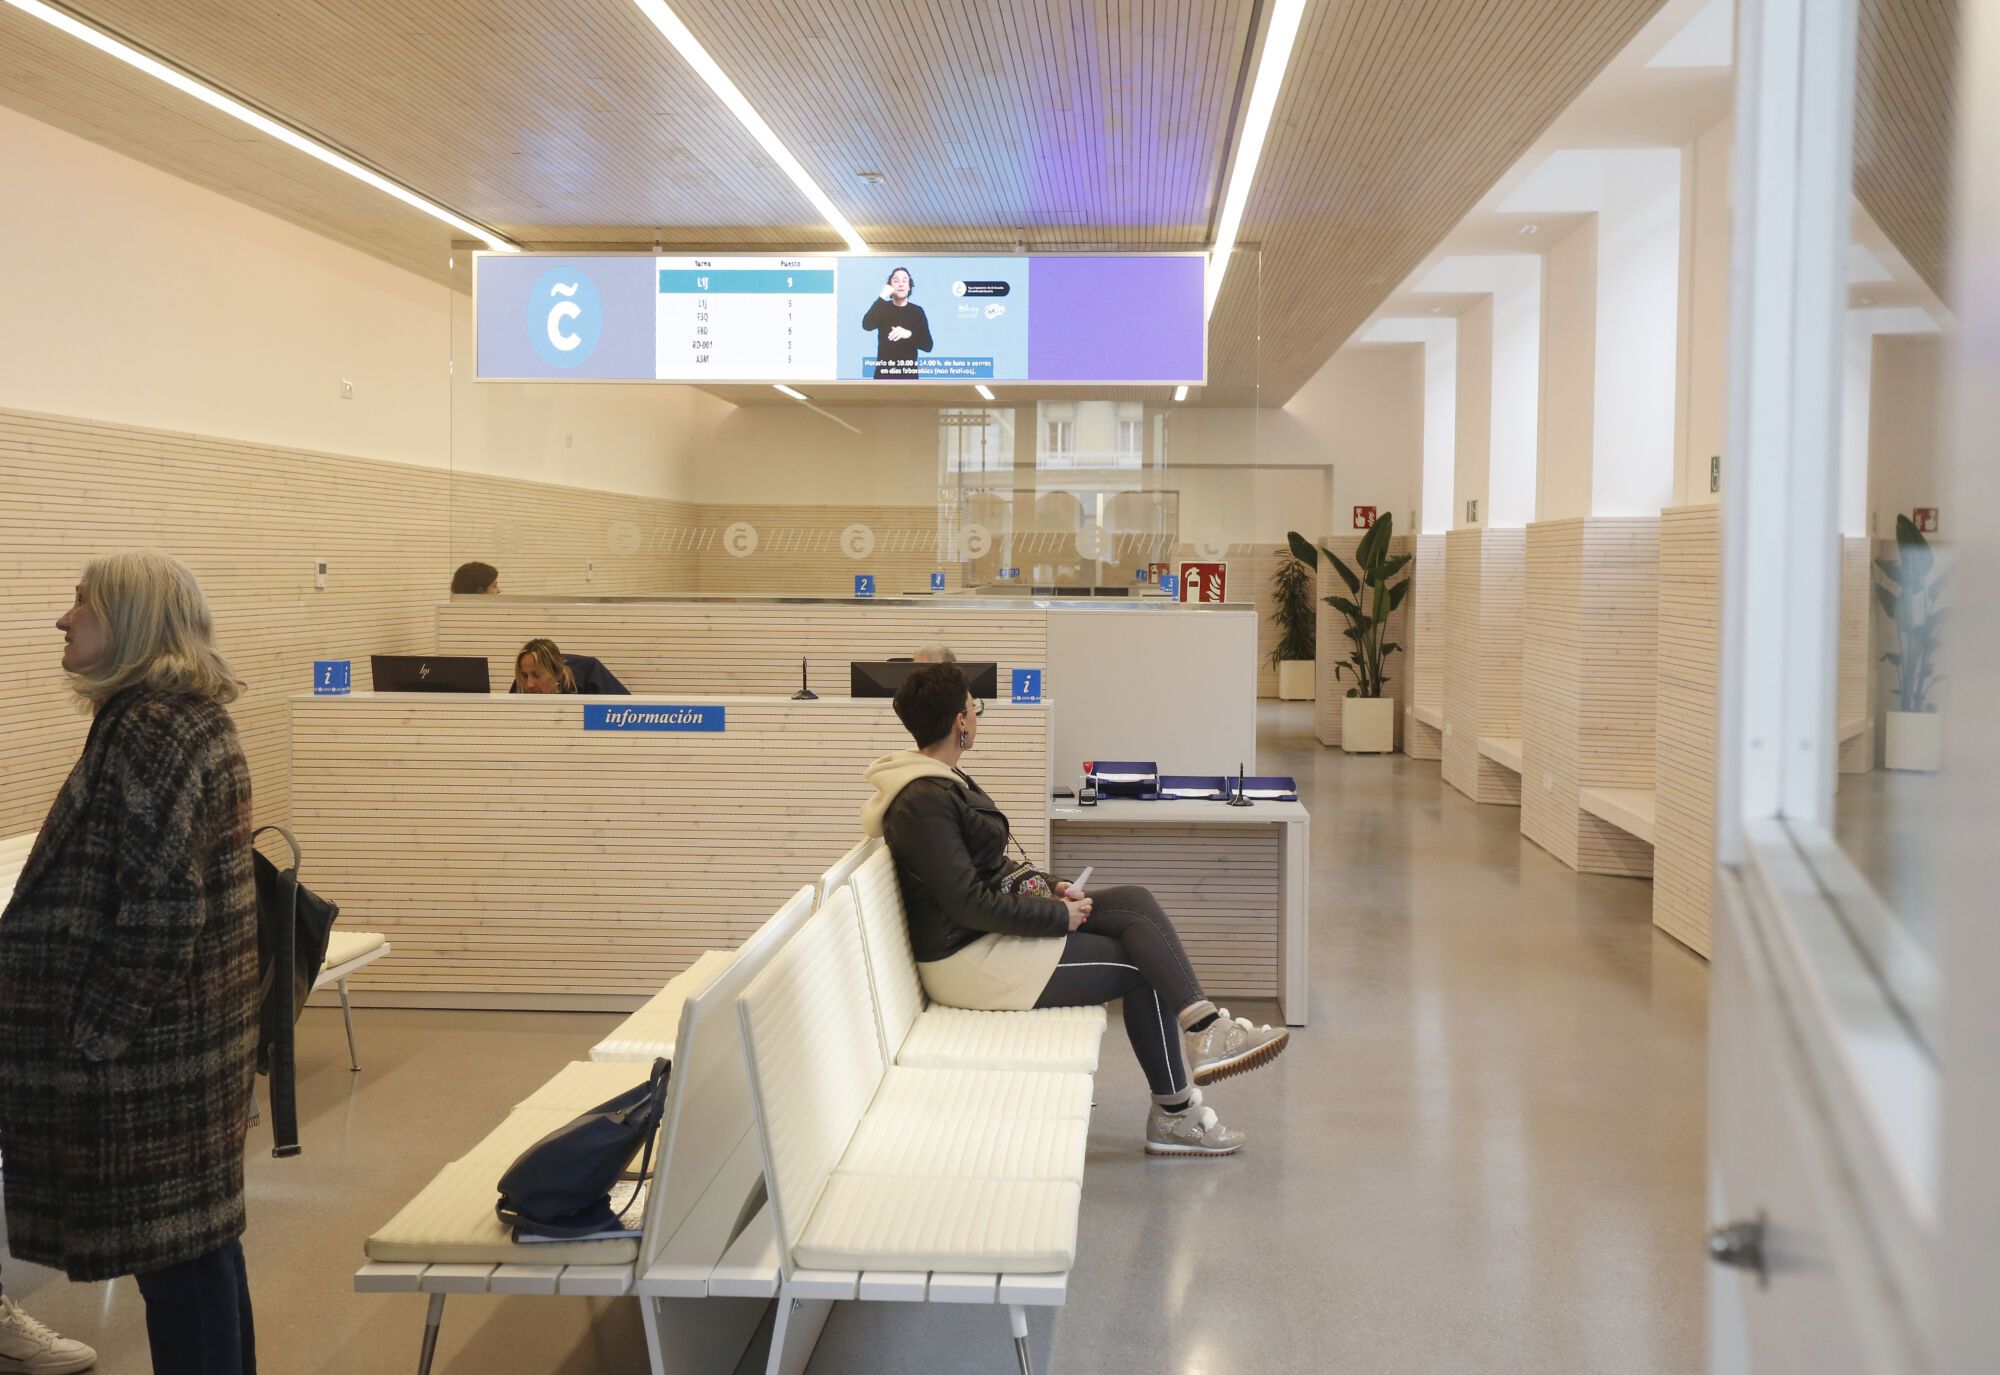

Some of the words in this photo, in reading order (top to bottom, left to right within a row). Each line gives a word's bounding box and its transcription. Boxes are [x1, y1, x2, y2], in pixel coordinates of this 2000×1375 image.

[780, 260, 801, 268] Puesto
[864, 359, 887, 367] Horario
[880, 367, 889, 375] en
[860, 579, 868, 591] 2
[325, 667, 332, 685] i
[420, 663, 430, 680] hp
[1023, 675, 1031, 693] i
[605, 709, 703, 727] información
